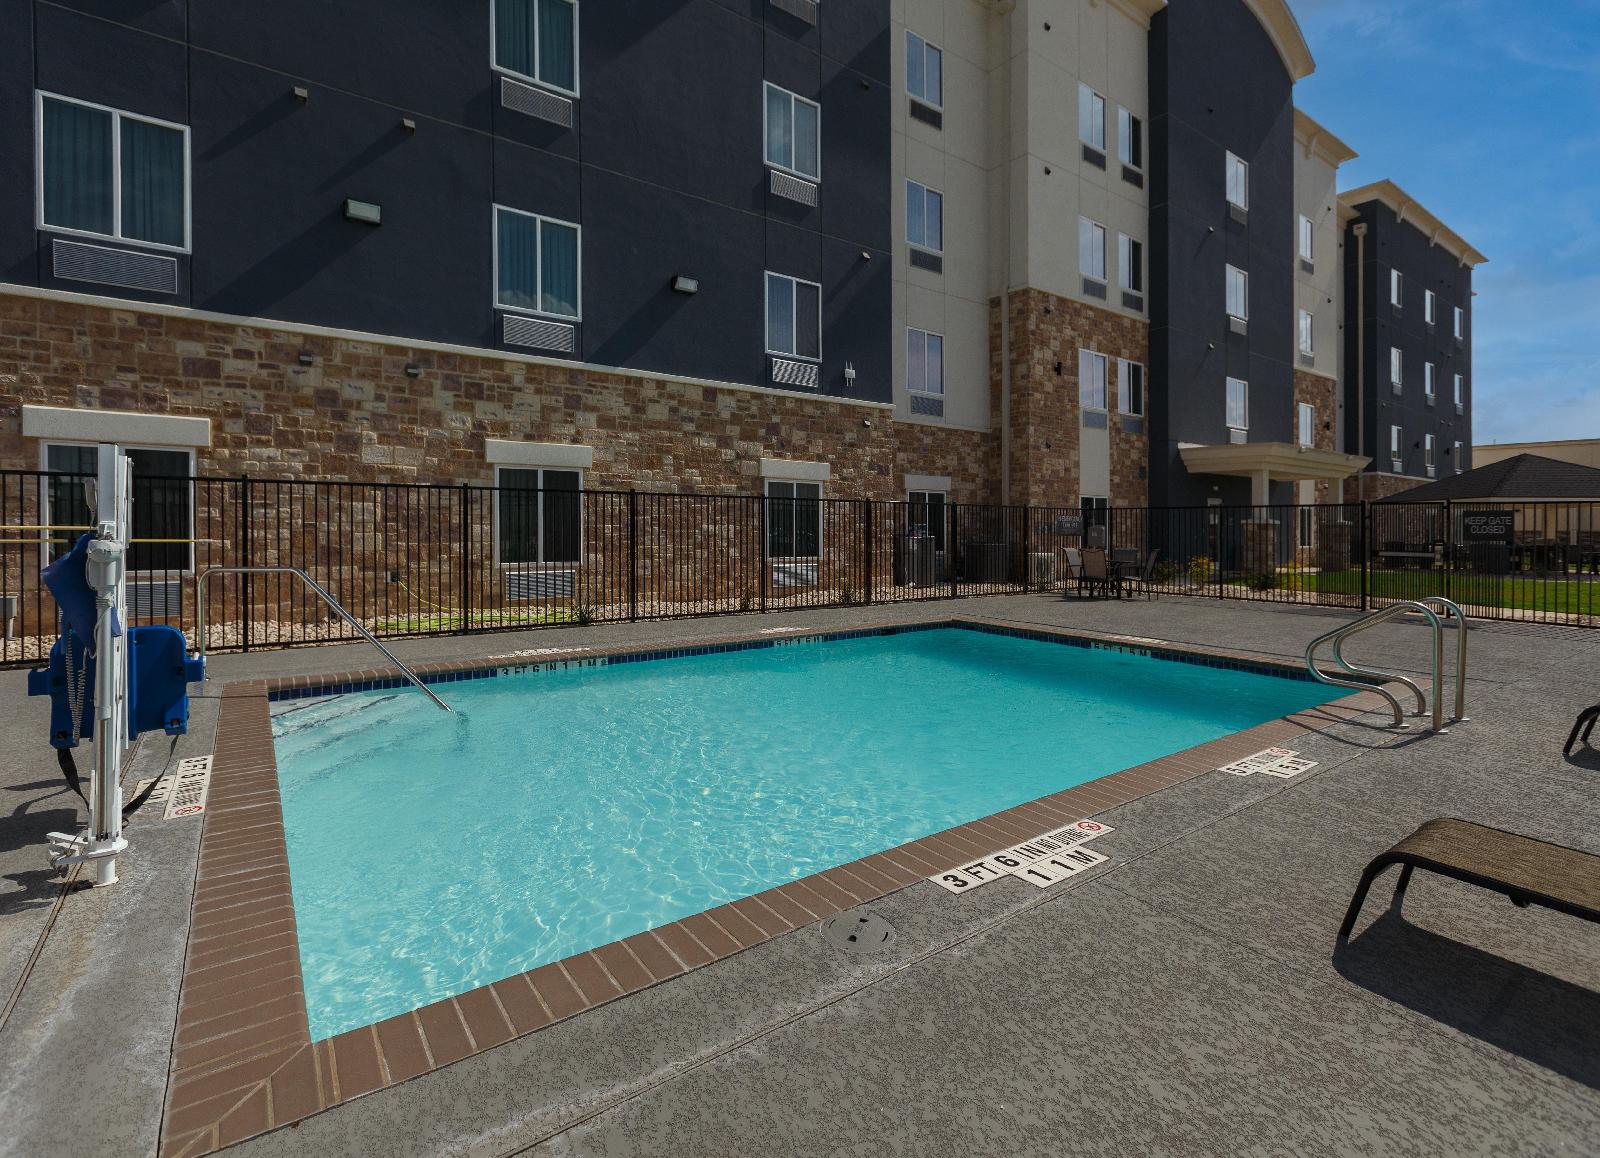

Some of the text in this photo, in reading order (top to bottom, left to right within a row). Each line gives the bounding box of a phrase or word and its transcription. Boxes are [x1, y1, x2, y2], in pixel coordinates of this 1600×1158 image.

[1465, 516, 1512, 525] KEEP GATE
[1471, 525, 1505, 534] CLOSED
[514, 665, 528, 674] FT
[545, 662, 557, 672] IN
[1065, 849, 1099, 865] M
[942, 874, 969, 888] 3
[962, 862, 998, 881] FT
[993, 855, 1020, 868] 6
[1013, 844, 1049, 860] IN
